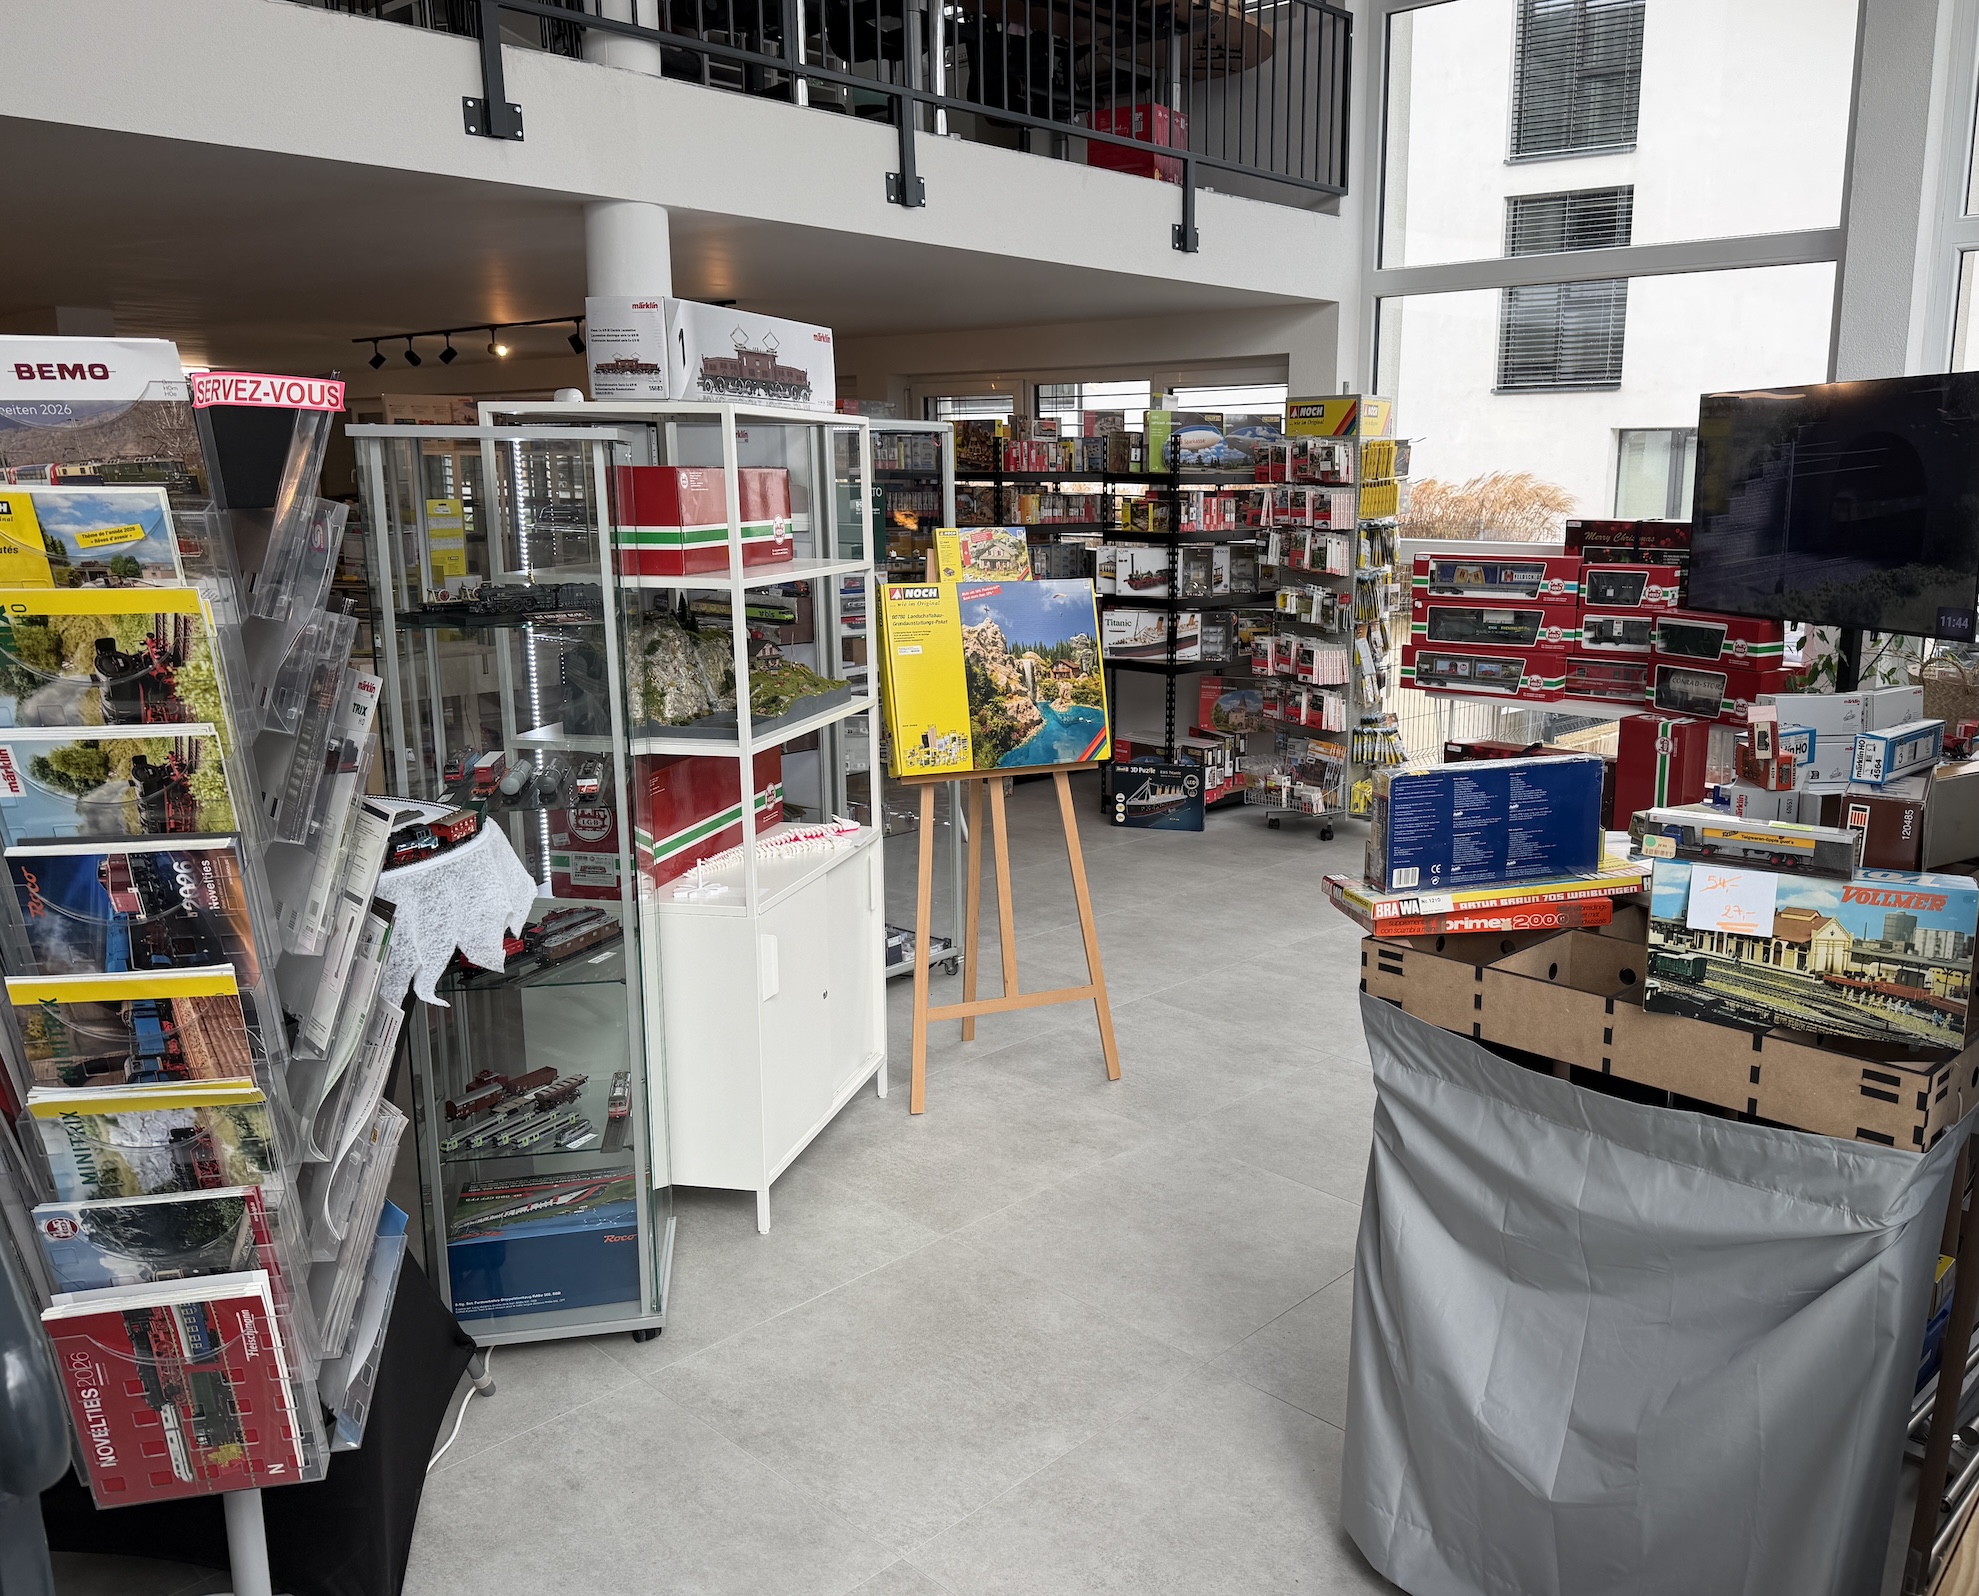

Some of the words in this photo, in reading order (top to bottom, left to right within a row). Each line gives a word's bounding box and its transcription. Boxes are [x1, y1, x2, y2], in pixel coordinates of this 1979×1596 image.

[631, 302, 658, 310] märklin
[813, 333, 831, 343] märklin
[678, 327, 686, 369] 1
[14, 363, 109, 380] BEMO
[197, 379, 340, 408] SERVEZ-VOUS
[40, 404, 72, 416] 2026
[1300, 406, 1324, 417] NOCH
[82, 530, 98, 539] Thème
[1584, 531, 1611, 543] Merry
[1613, 531, 1655, 543] Chrismas
[904, 588, 938, 598] NOCH
[1104, 618, 1133, 627] Titanic
[1940, 616, 1969, 629] 11:44
[352, 702, 368, 717] TRIX
[1138, 766, 1156, 774] Puzzle
[1856, 750, 1866, 778] märklin
[1873, 758, 1883, 779] 4564
[1901, 809, 1914, 840] 120485
[21, 866, 46, 918] Roco
[201, 860, 221, 910] Novelties
[1459, 899, 1497, 910] ARTUR
[1500, 895, 1540, 907] BRAUN
[1567, 885, 1638, 900] WAIBLINGEN
[1841, 885, 1948, 912] VOLLMER
[59, 1110, 99, 1185] MINITRIX
[603, 1233, 638, 1244] Roco
[236, 1309, 260, 1362] Fleischmann
[70, 1351, 97, 1388] 2026
[80, 1387, 118, 1468] NOVELTIES
[266, 1463, 286, 1475] N
